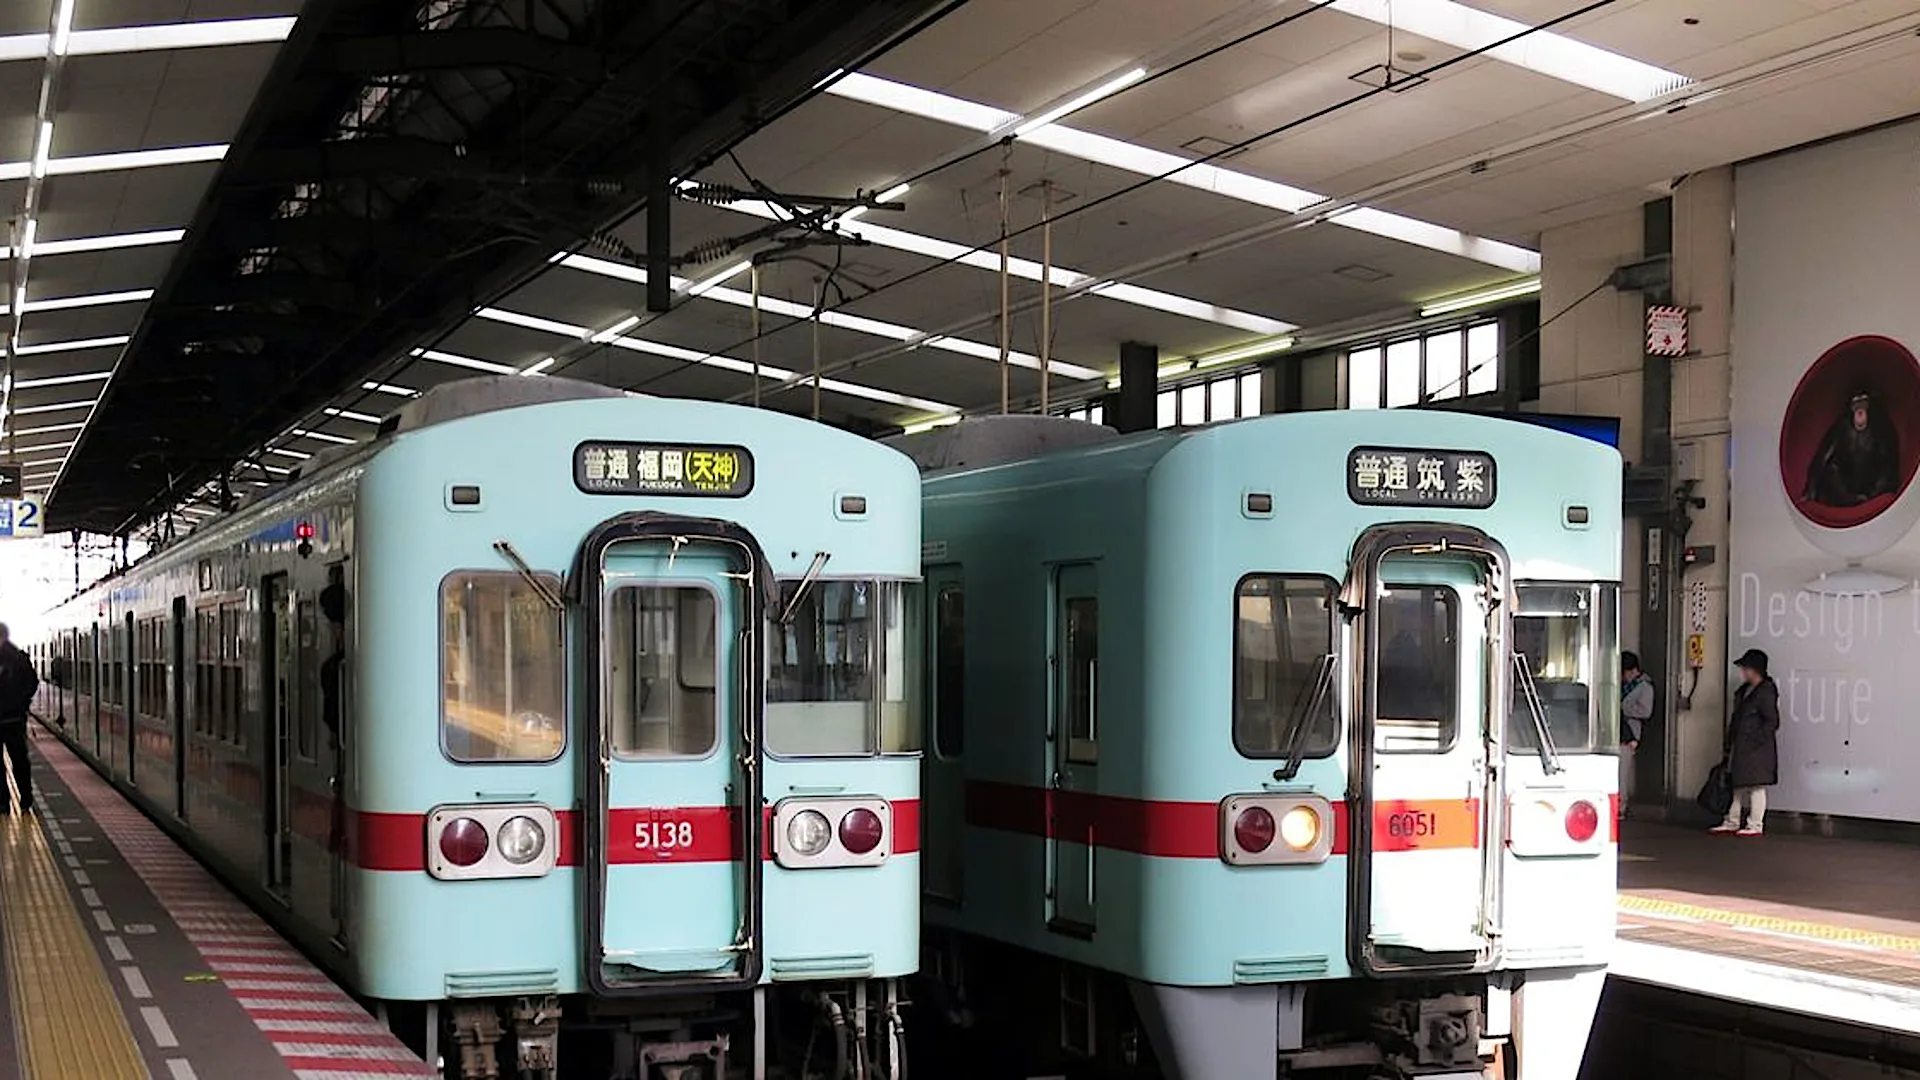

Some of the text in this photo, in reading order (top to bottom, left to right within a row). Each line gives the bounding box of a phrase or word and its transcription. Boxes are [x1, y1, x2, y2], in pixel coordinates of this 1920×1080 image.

[584, 448, 629, 479] 普通
[1355, 454, 1409, 489] 普通
[588, 480, 624, 489] LOCAL
[638, 480, 684, 490] FUKUOKA
[1365, 489, 1481, 502] LOCAL CHIKUSHI
[18, 501, 38, 528] 2
[1740, 572, 1883, 654] Design
[1775, 669, 1873, 725] ture
[635, 822, 693, 849] 5138
[1389, 812, 1435, 837] 6051
